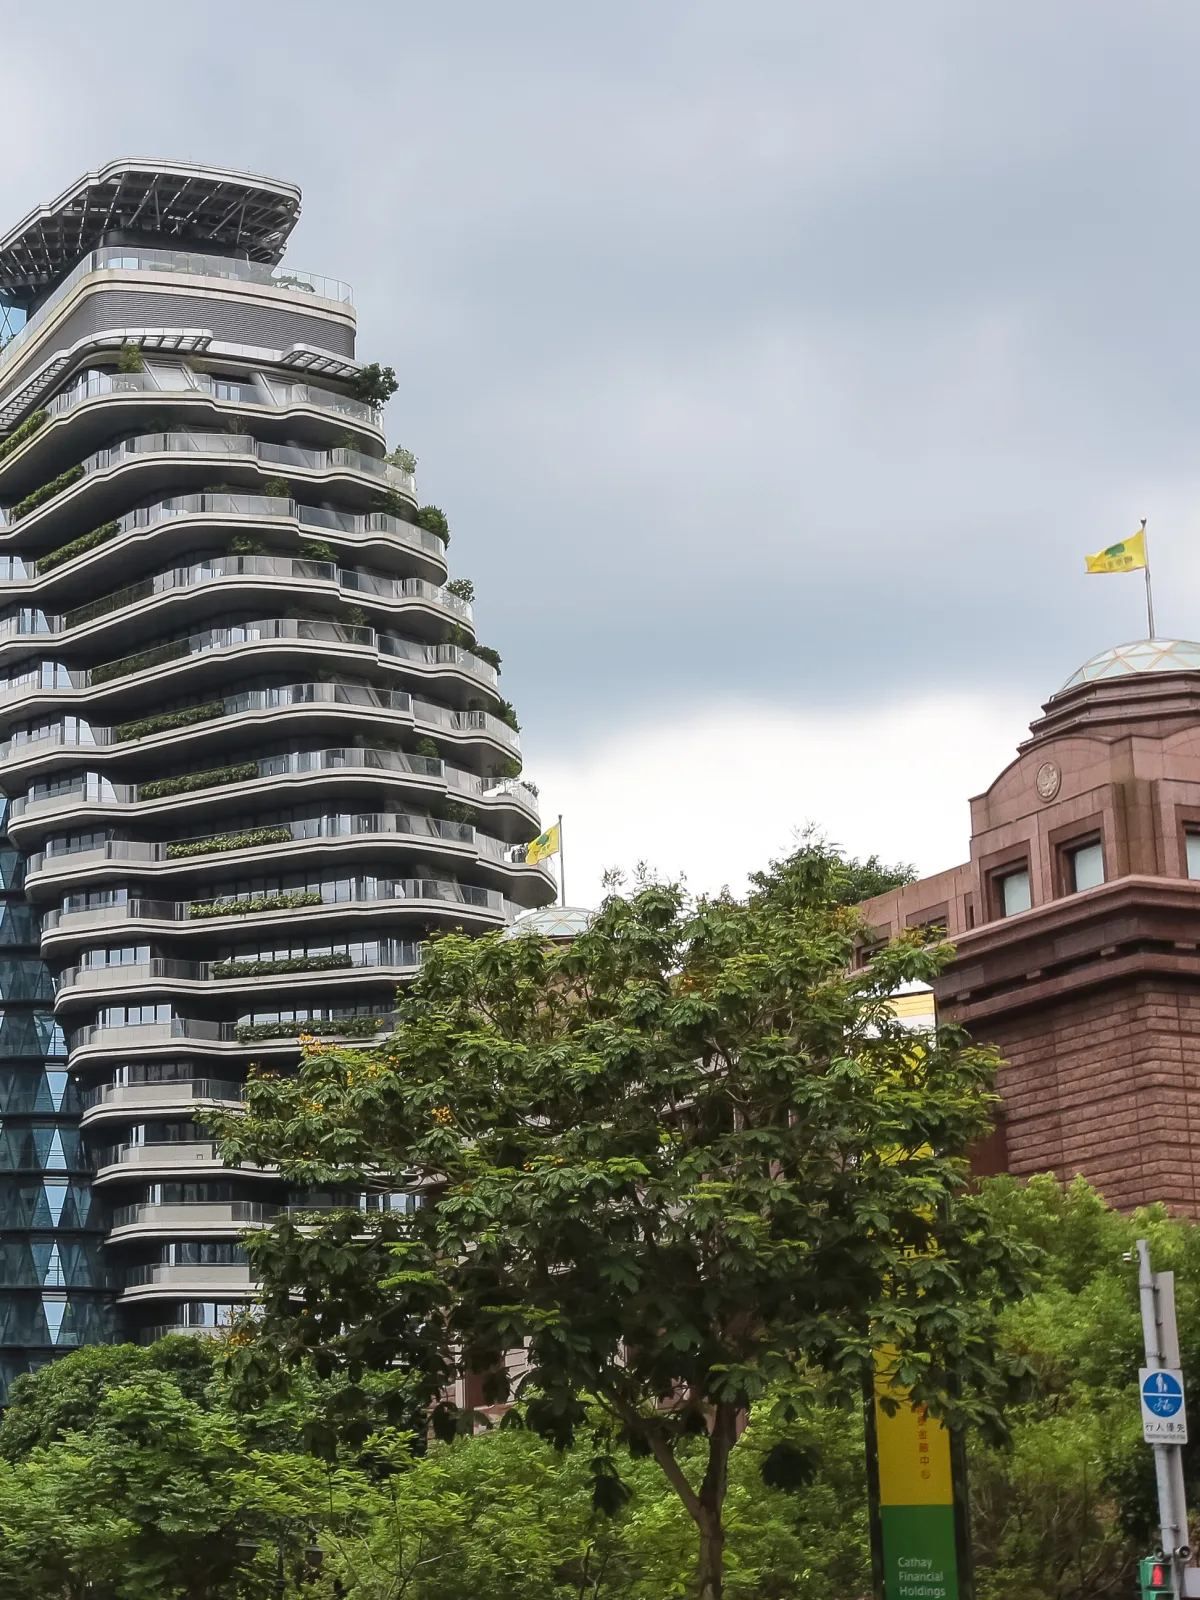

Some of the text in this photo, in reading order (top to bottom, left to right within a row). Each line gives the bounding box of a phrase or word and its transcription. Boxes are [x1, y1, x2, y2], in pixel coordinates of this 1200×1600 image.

[1145, 1421, 1185, 1433] 行人優先
[898, 1556, 932, 1570] Cathay
[899, 1571, 944, 1582] Financial
[900, 1586, 946, 1599] Holdings
